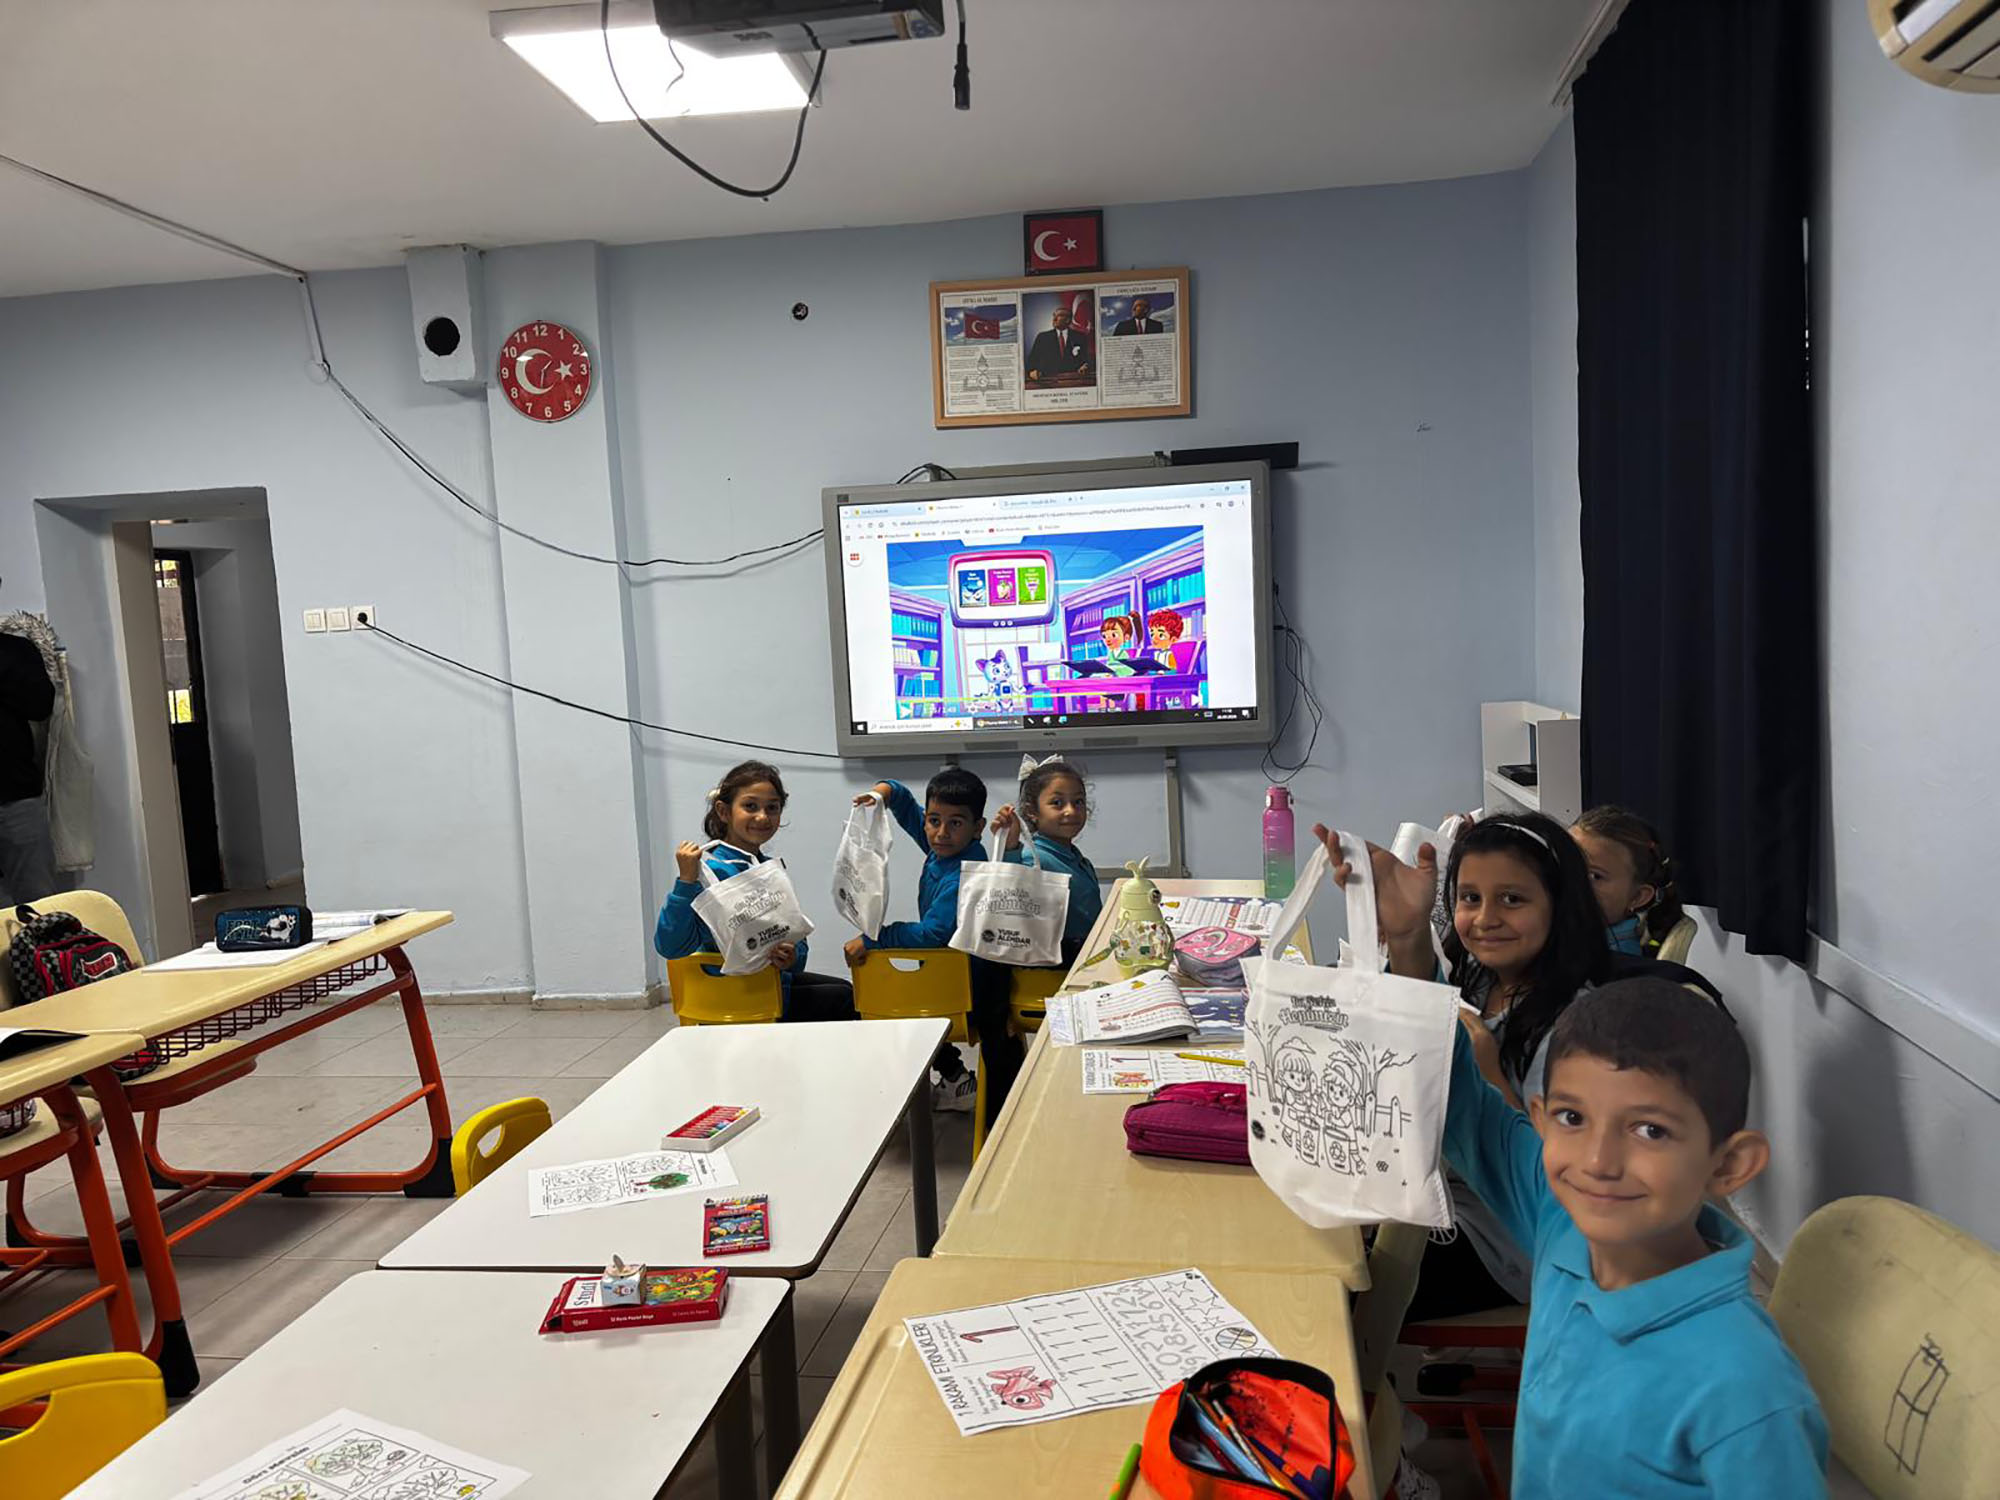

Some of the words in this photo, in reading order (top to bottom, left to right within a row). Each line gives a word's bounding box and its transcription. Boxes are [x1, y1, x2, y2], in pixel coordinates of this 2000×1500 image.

[533, 324, 548, 337] 12
[558, 329, 564, 340] 1
[514, 332, 528, 343] 11
[503, 346, 517, 358] 10
[572, 344, 580, 355] 2
[501, 368, 509, 379] 9
[580, 364, 587, 375] 3
[510, 387, 518, 398] 8
[574, 384, 582, 395] 4
[526, 403, 533, 414] 7
[564, 401, 571, 412] 5
[544, 407, 552, 418] 6
[996, 936, 1030, 945] ALEMDAR
[937, 1375, 971, 1410] RAKAMI
